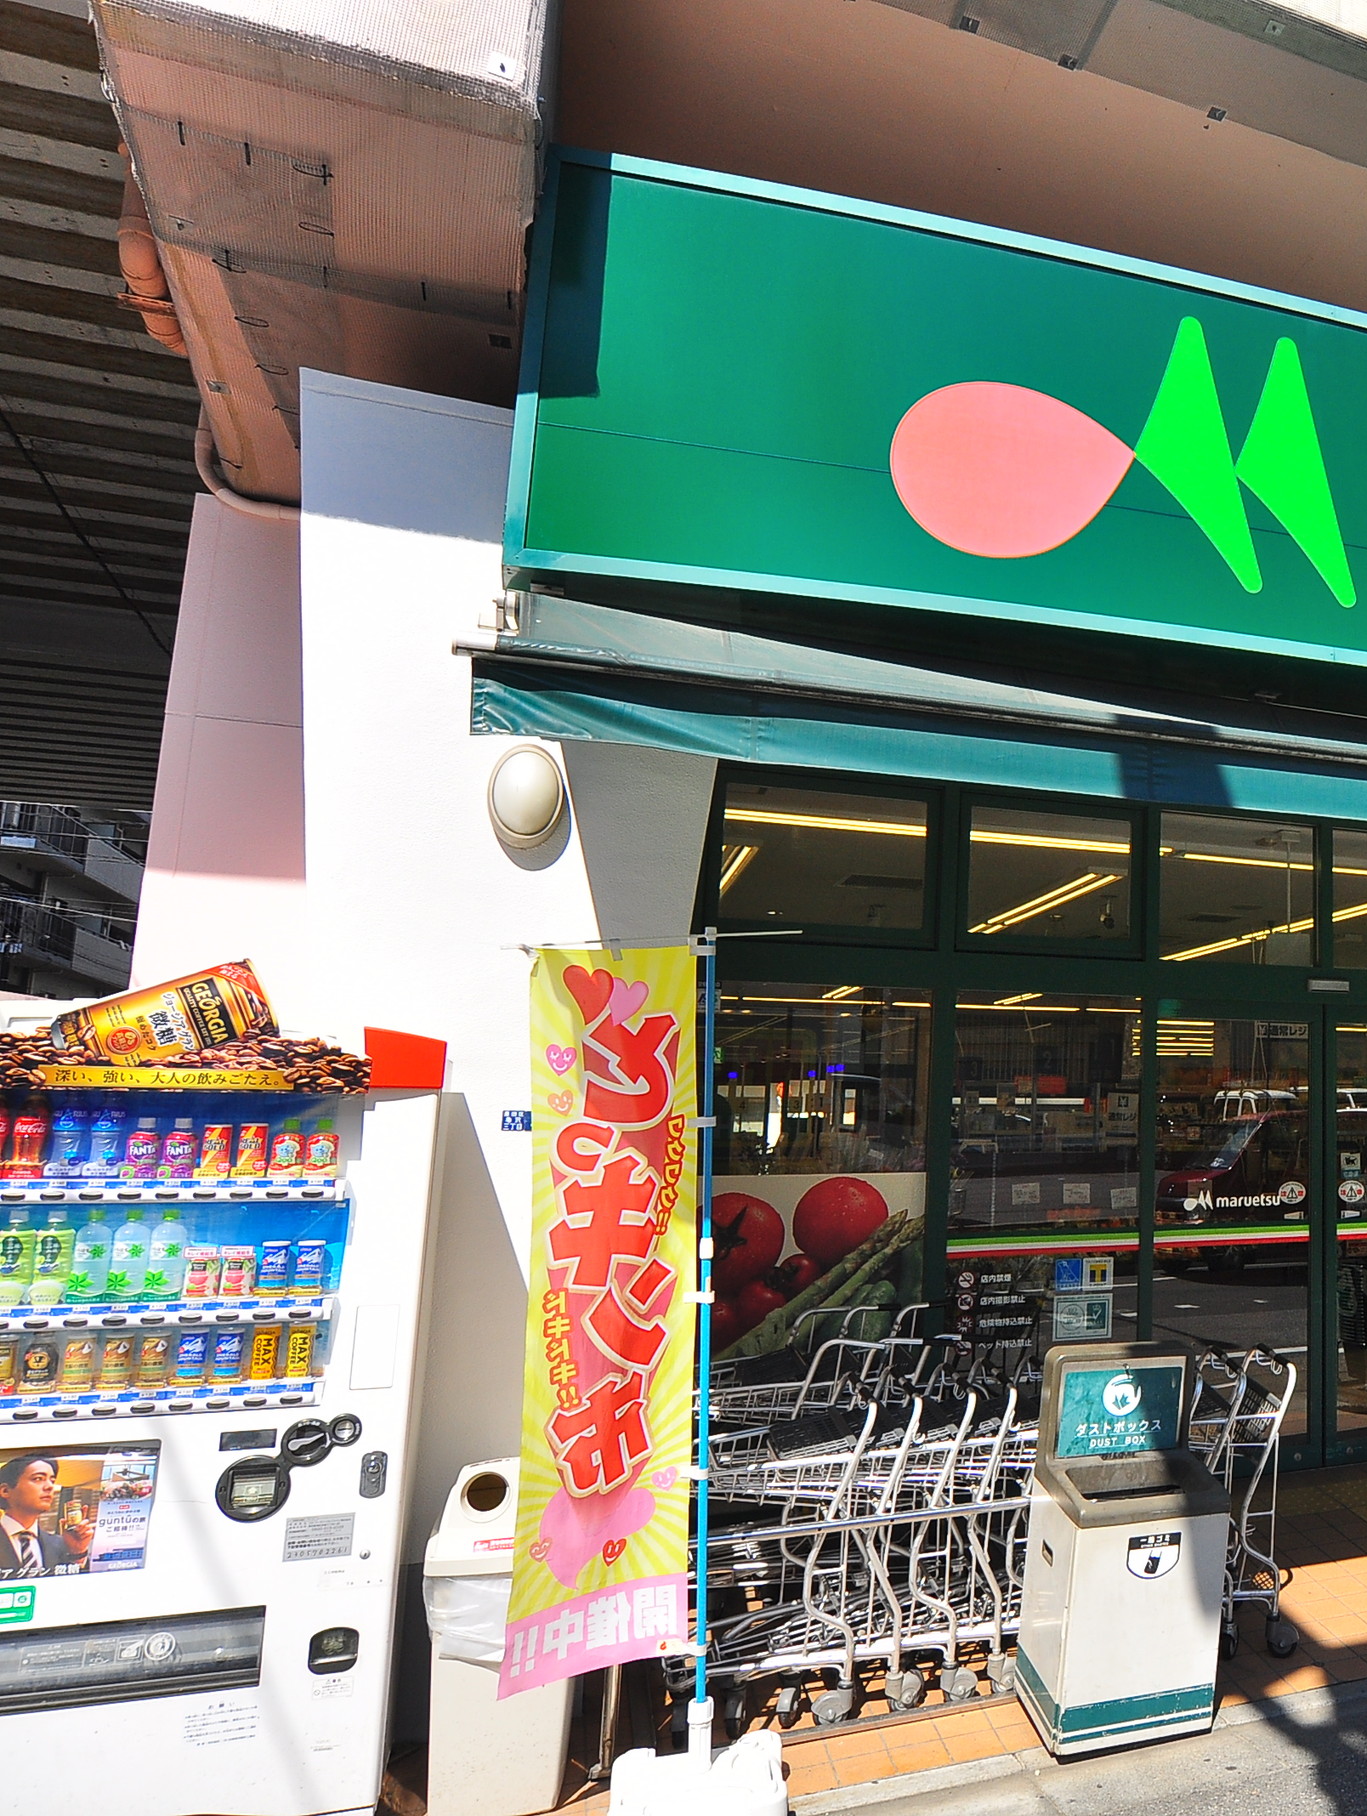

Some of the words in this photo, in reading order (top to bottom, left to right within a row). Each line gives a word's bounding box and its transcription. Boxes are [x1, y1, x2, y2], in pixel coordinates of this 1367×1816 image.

[192, 982, 229, 1043] GEORGIA
[1216, 1193, 1281, 1208] maruetsu
[260, 1338, 273, 1366] MAX
[296, 1336, 309, 1364] MAX
[1076, 1419, 1162, 1436] ダストボックス
[1089, 1437, 1118, 1447] DUST
[1124, 1435, 1146, 1444] BOX
